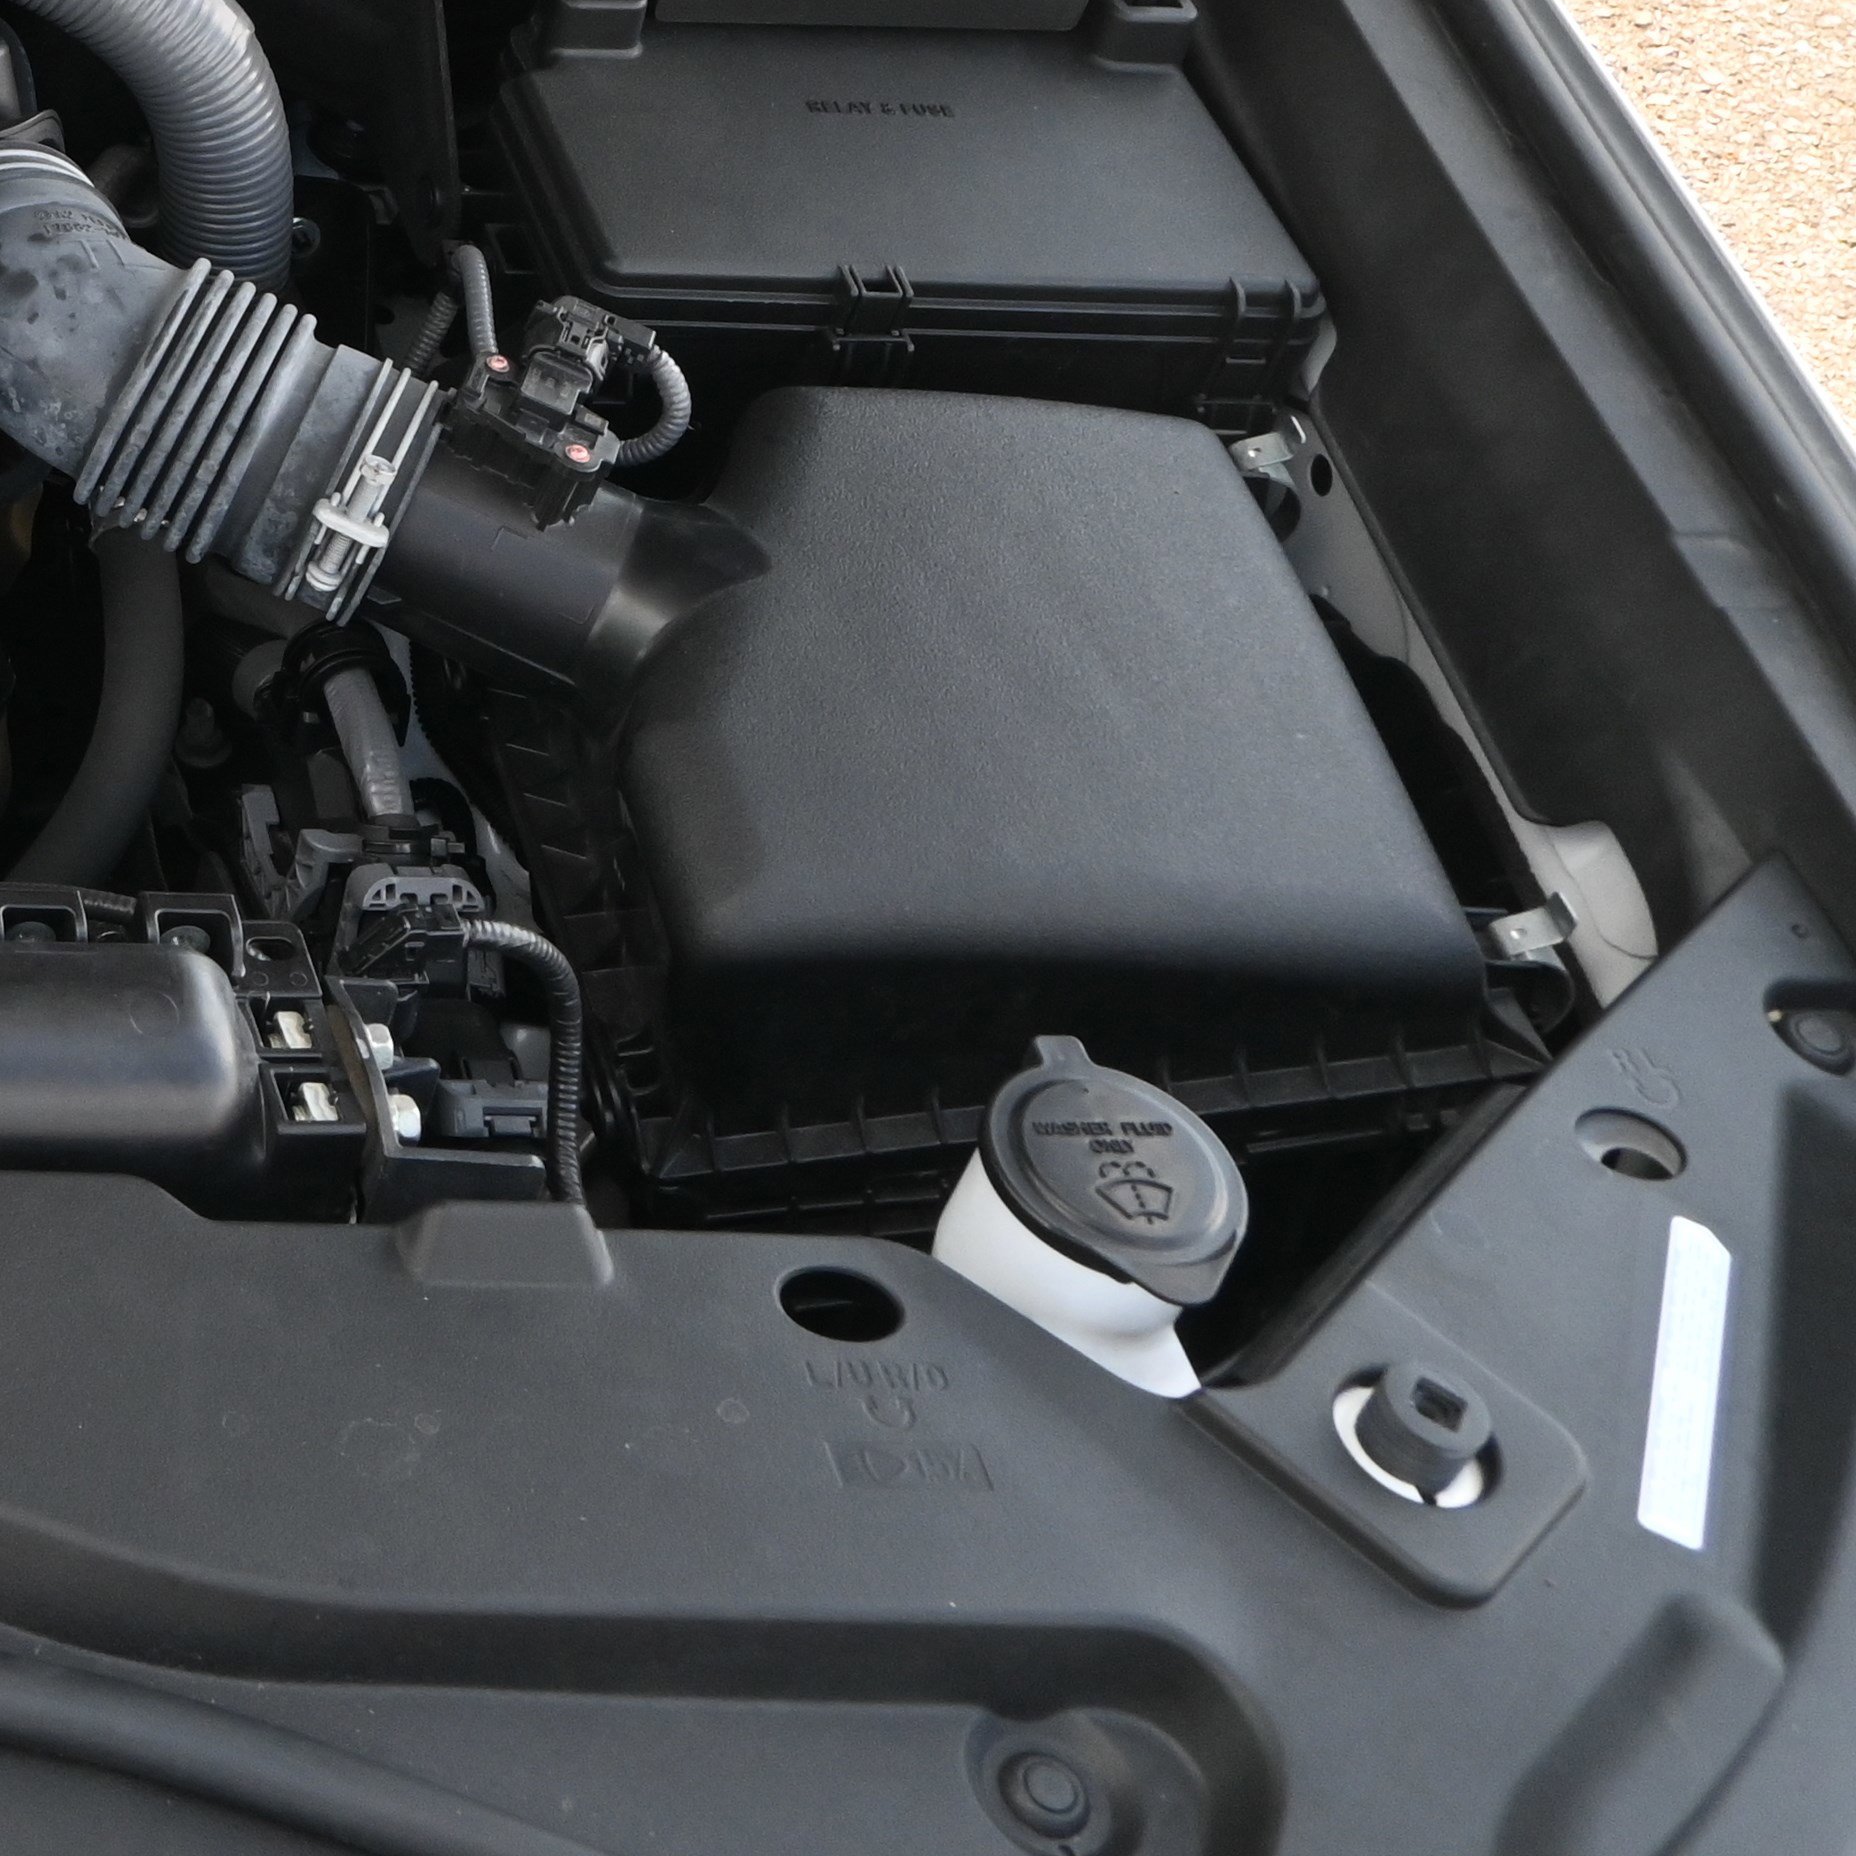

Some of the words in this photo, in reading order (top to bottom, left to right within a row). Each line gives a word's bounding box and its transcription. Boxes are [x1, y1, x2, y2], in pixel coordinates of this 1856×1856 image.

[804, 99, 873, 115] RELAY
[900, 103, 956, 118] FUSE
[1119, 1120, 1175, 1138] FLUID
